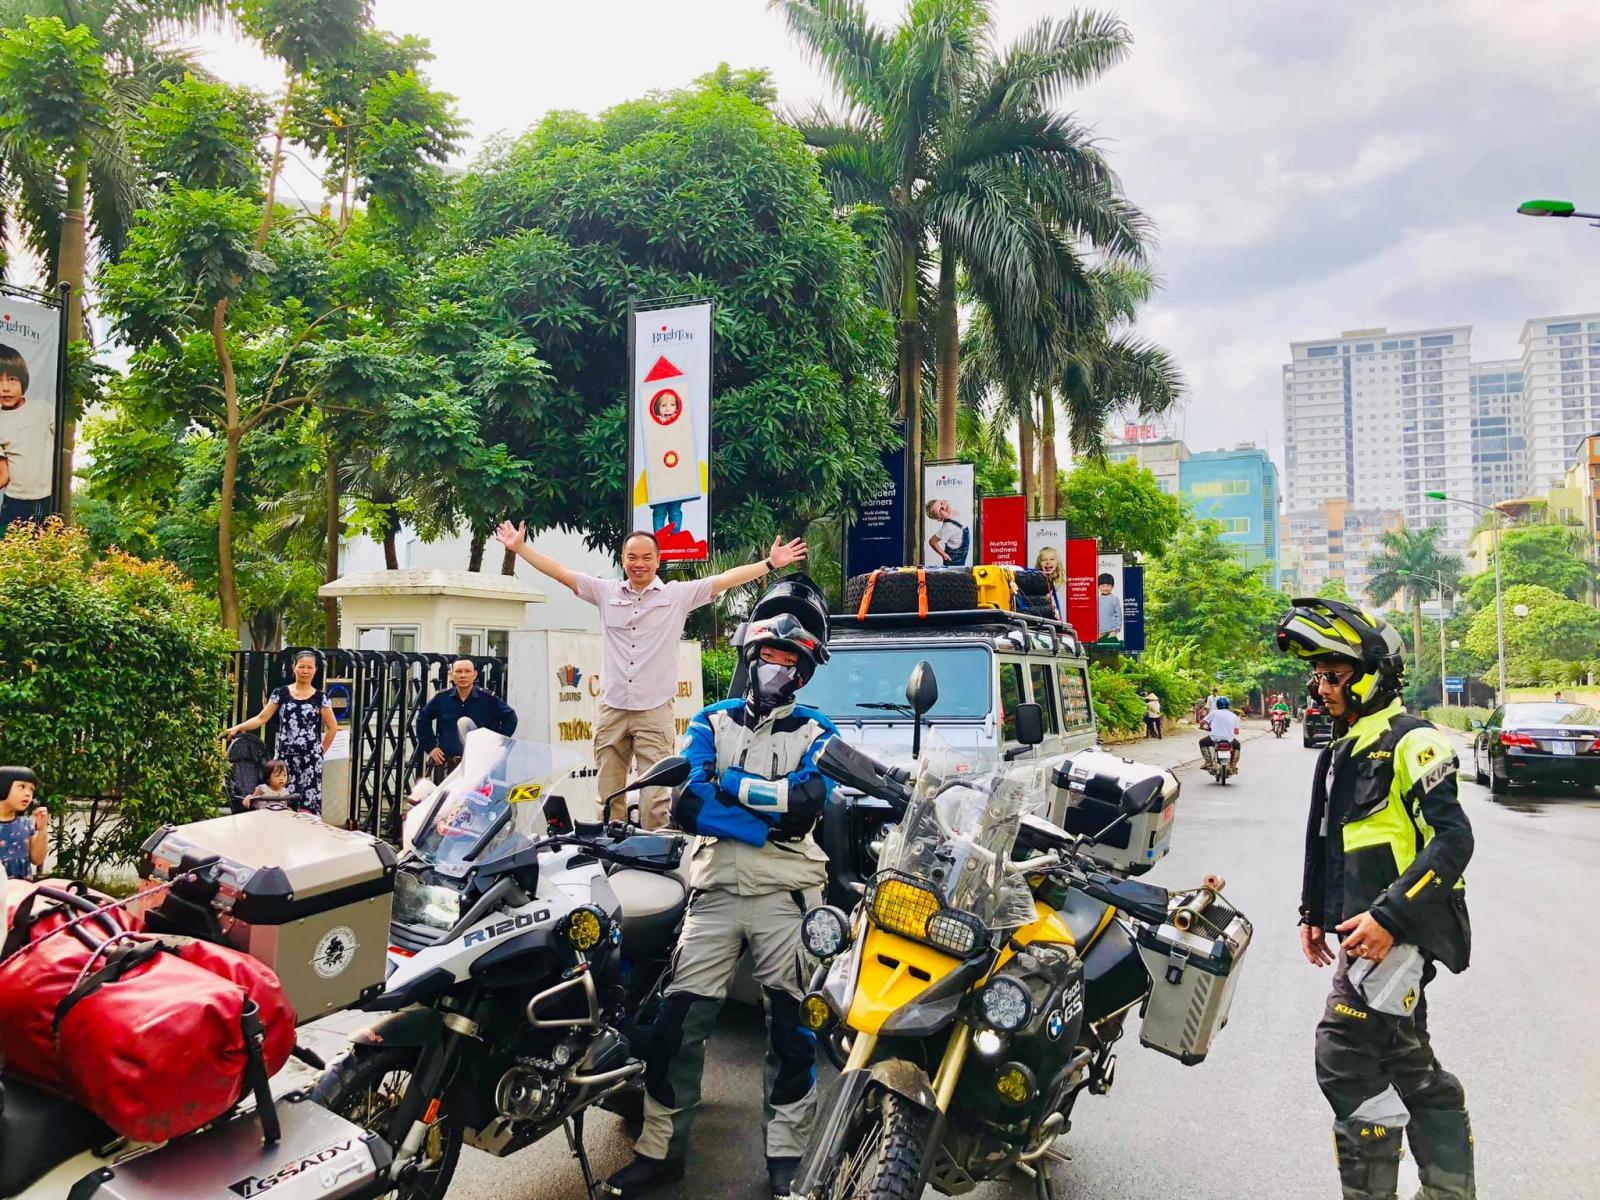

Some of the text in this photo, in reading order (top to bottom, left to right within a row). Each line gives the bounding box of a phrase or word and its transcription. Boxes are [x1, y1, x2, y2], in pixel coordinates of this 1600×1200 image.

[559, 692, 581, 702] LOUIS
[463, 908, 551, 948] R1200
[1062, 980, 1081, 1009] F800
[1064, 994, 1083, 1023] GS
